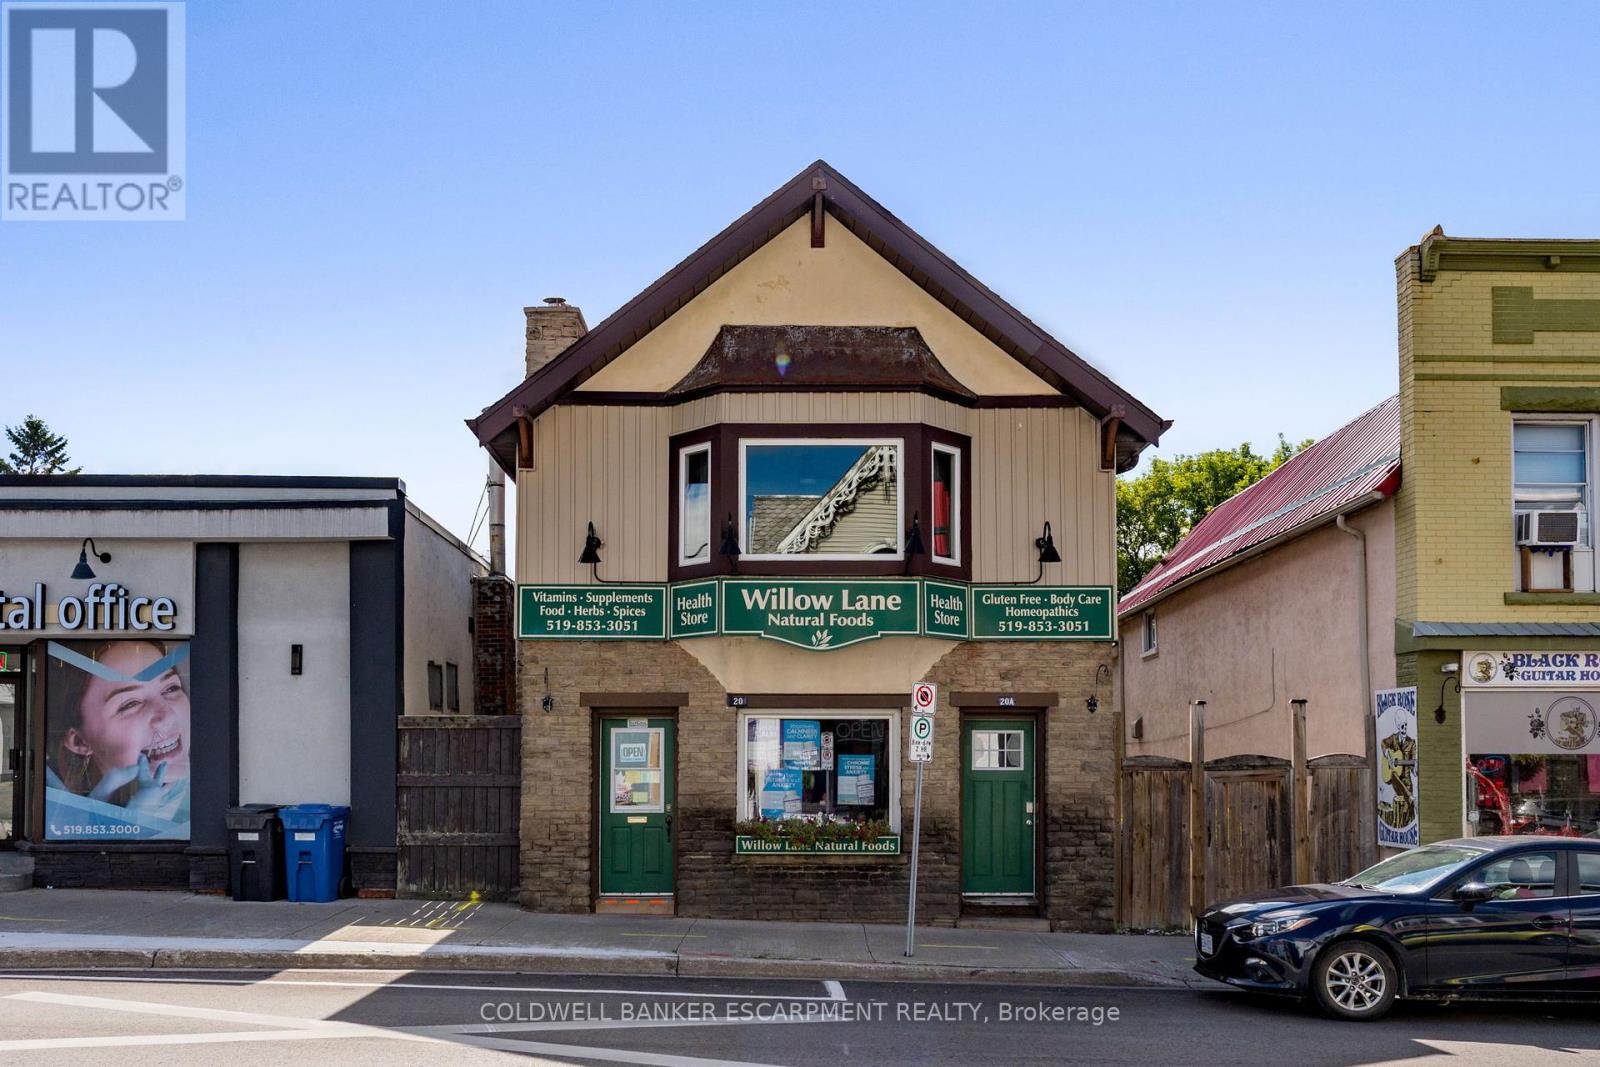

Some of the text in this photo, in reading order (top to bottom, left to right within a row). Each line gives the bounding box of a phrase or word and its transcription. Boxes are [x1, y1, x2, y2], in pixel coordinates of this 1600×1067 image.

[533, 592, 653, 604] Vitamins Supplements
[677, 592, 712, 611] Health
[741, 587, 902, 611] Willow Lane
[930, 593, 963, 611] Health
[982, 593, 1102, 606] Gluten Free Body Care
[58, 583, 177, 630] office
[539, 605, 646, 618] Food Herbs Spices
[1005, 605, 1079, 618] Homeopathics
[680, 611, 709, 626] Store
[768, 612, 874, 627] Natural Foods
[934, 610, 961, 626] Store
[546, 620, 638, 632] 519-853-3051
[998, 620, 1089, 632] 519-853-3051
[1512, 653, 1600, 668] BLACK R
[1520, 670, 1576, 681] GUITAR
[733, 697, 744, 705] 20
[1000, 697, 1015, 706] 20A
[835, 722, 884, 738] OPEN
[623, 747, 643, 757] OPEN
[63, 824, 140, 835] 519.853.3000
[741, 839, 782, 850] Willow
[815, 840, 858, 850] Natural
